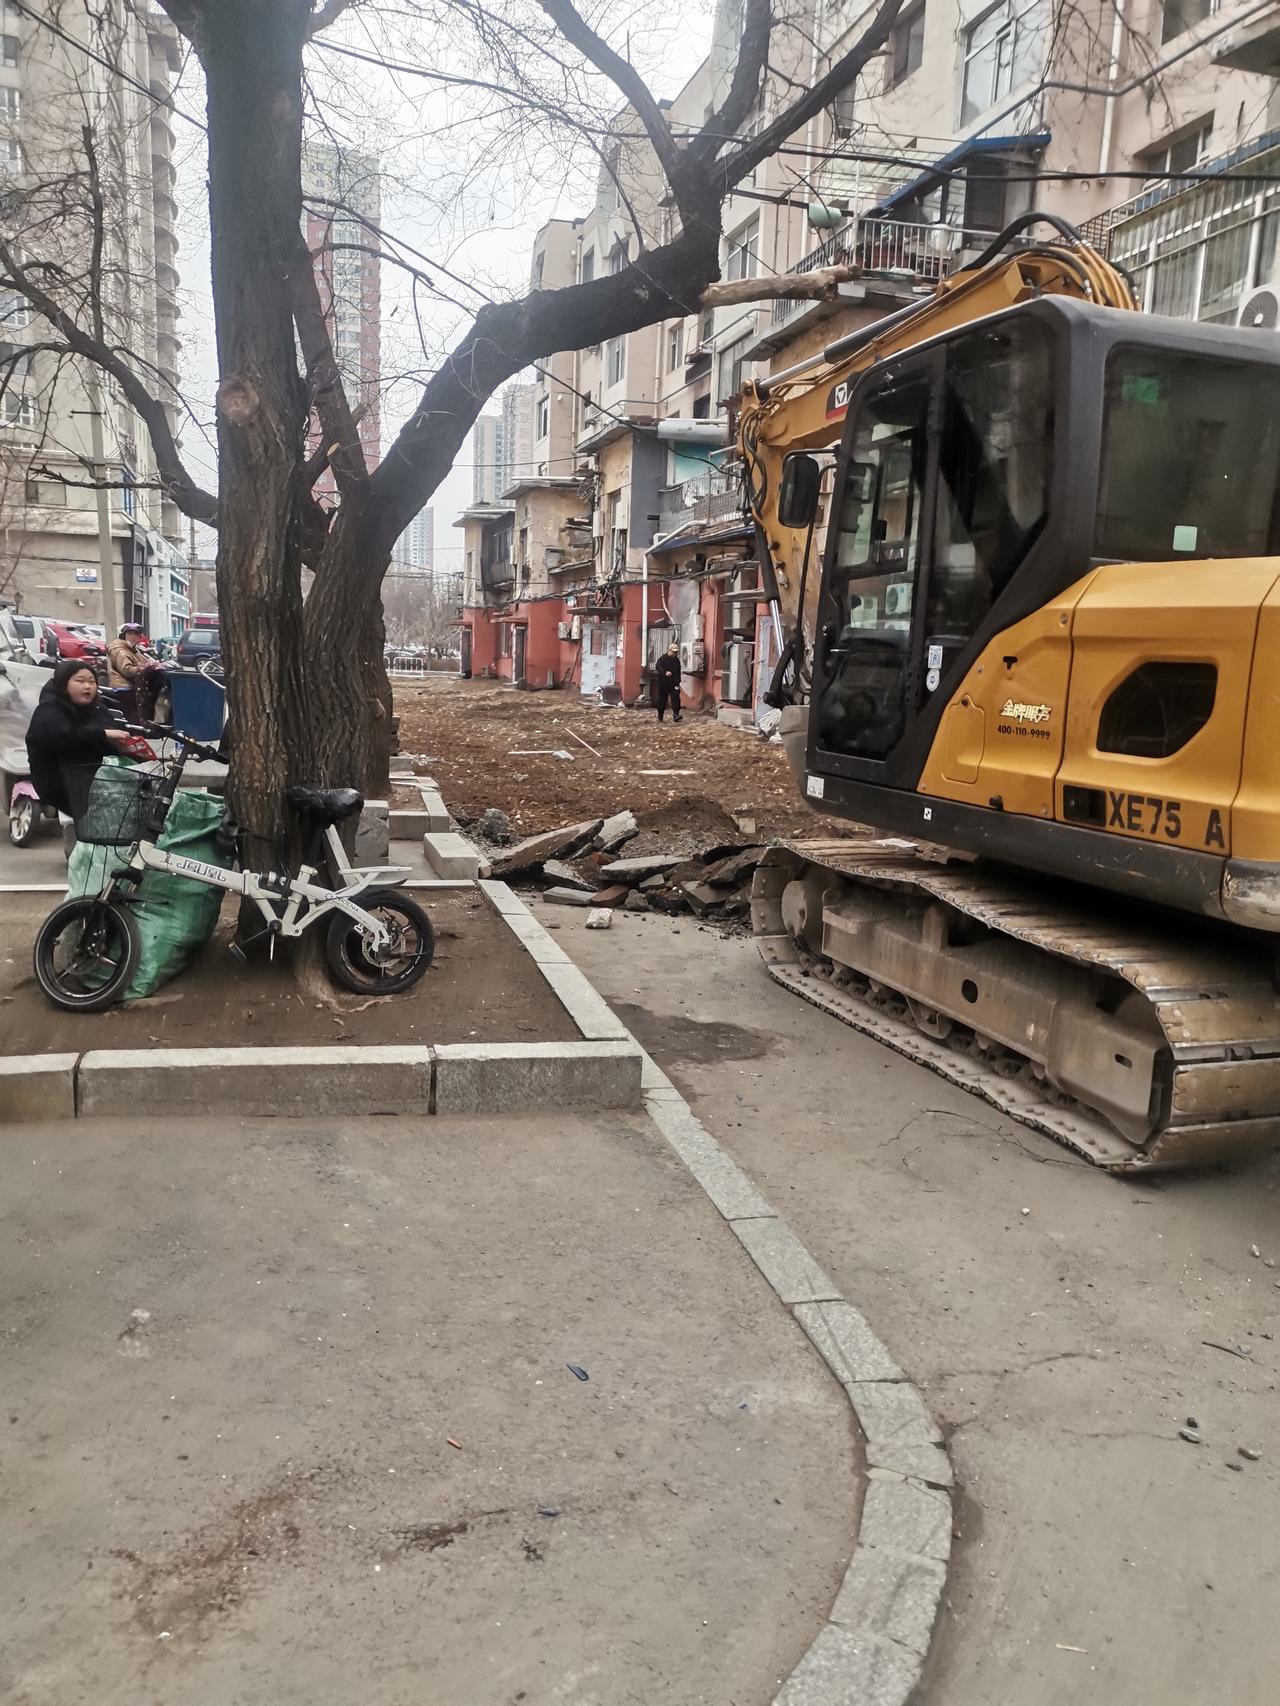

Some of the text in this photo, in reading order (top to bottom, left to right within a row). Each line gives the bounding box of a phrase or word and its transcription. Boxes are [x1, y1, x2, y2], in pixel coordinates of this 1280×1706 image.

[1000, 698, 1053, 724] 金牌服务
[997, 725, 1051, 740] 400-110-9999
[1108, 791, 1181, 839] XE75
